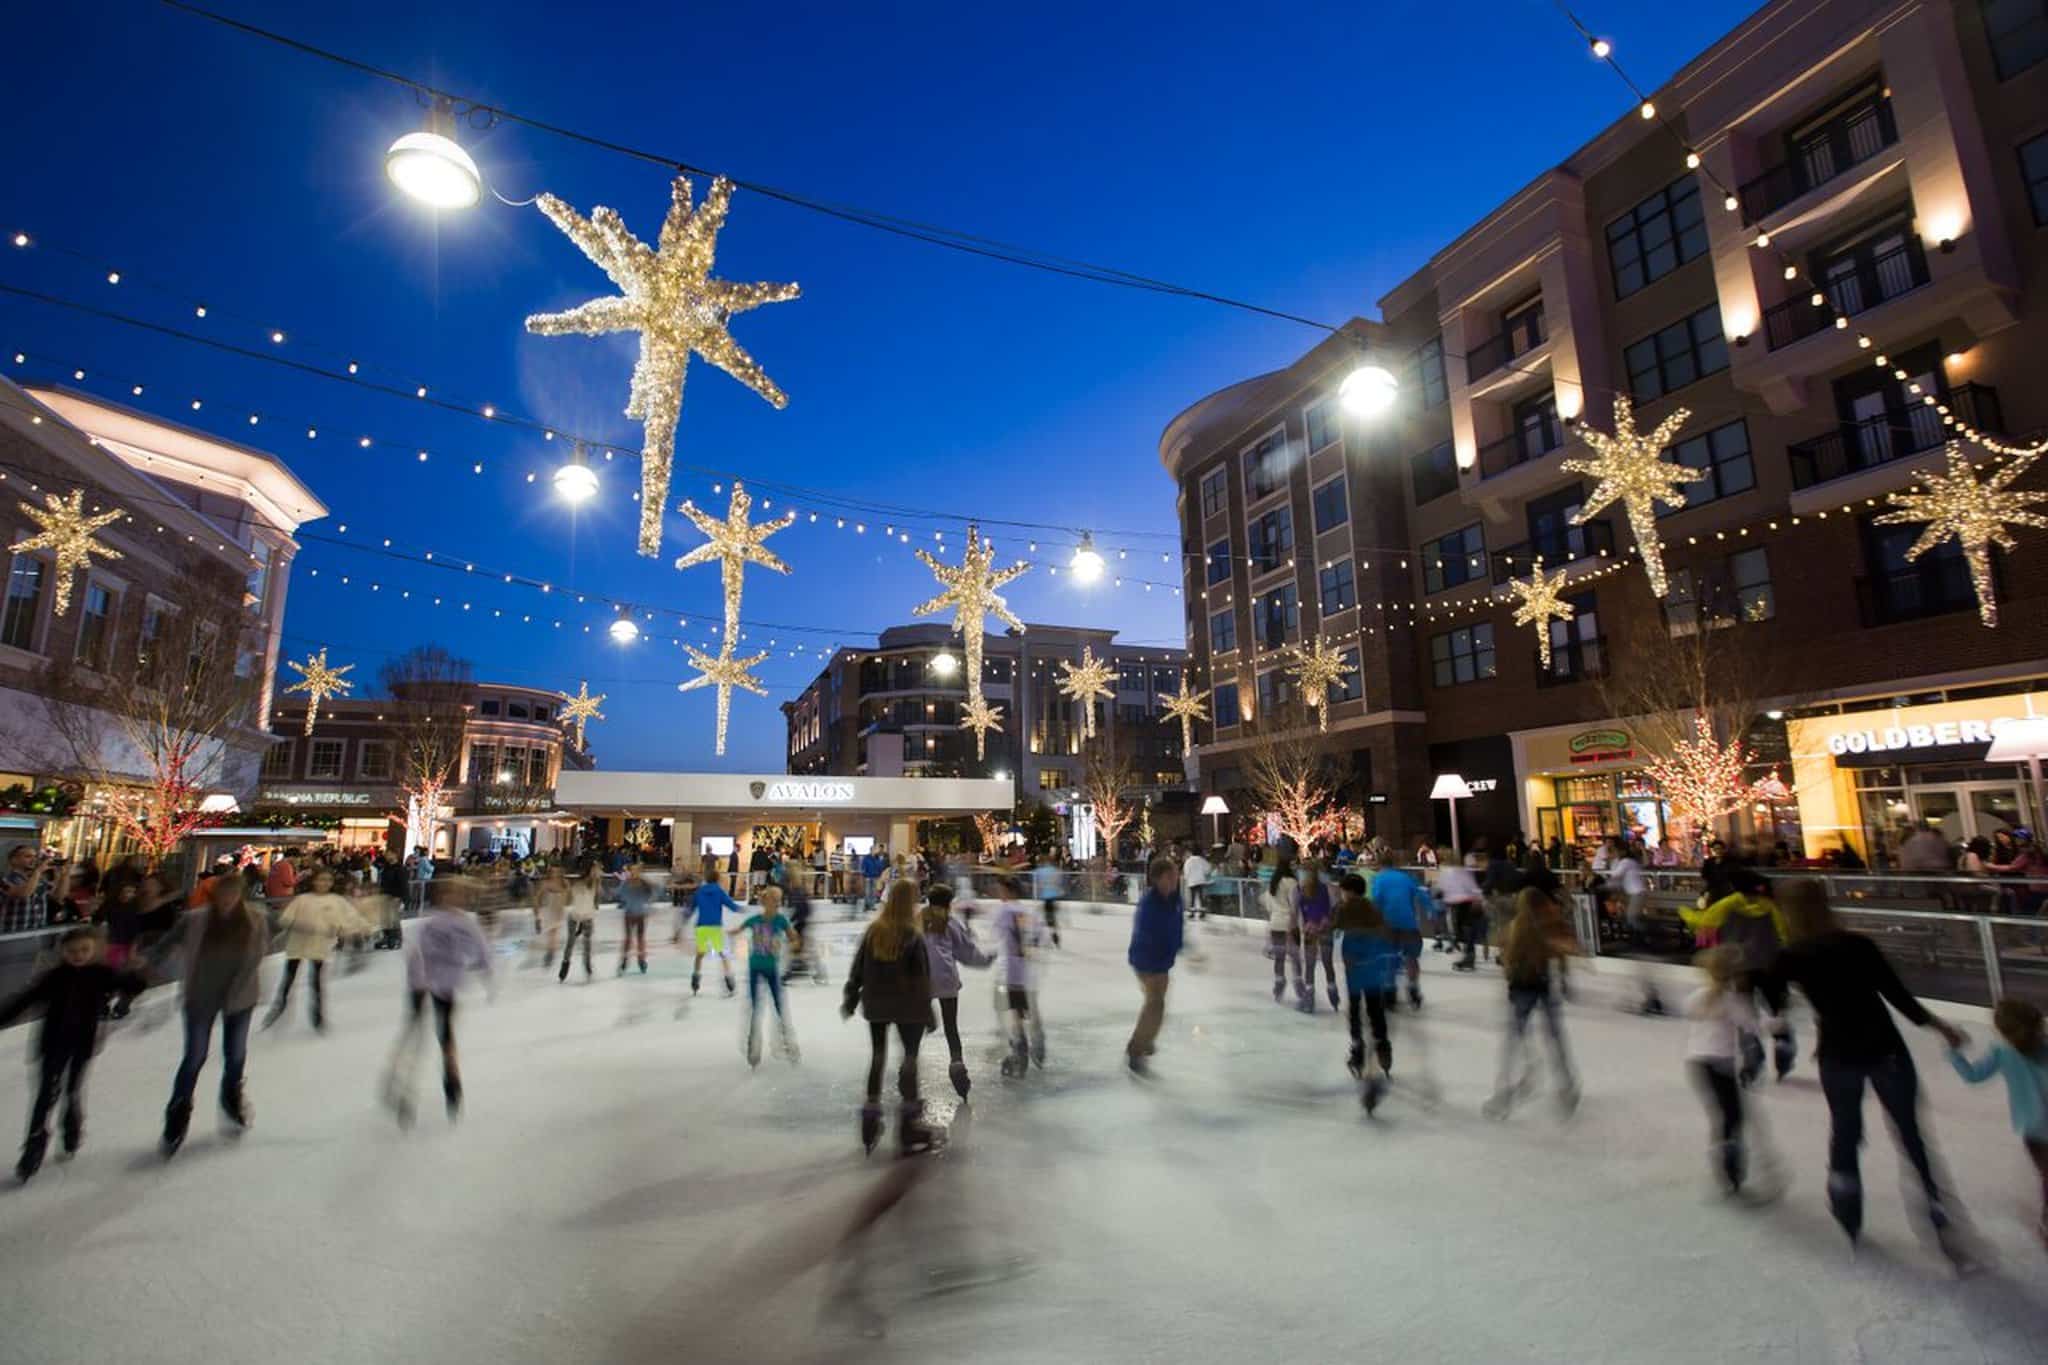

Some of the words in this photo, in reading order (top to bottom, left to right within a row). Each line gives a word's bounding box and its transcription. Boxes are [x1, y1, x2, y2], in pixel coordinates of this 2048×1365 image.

[263, 791, 313, 804] BANNA
[314, 792, 370, 804] REPUBLIC
[767, 783, 856, 801] AVALON
